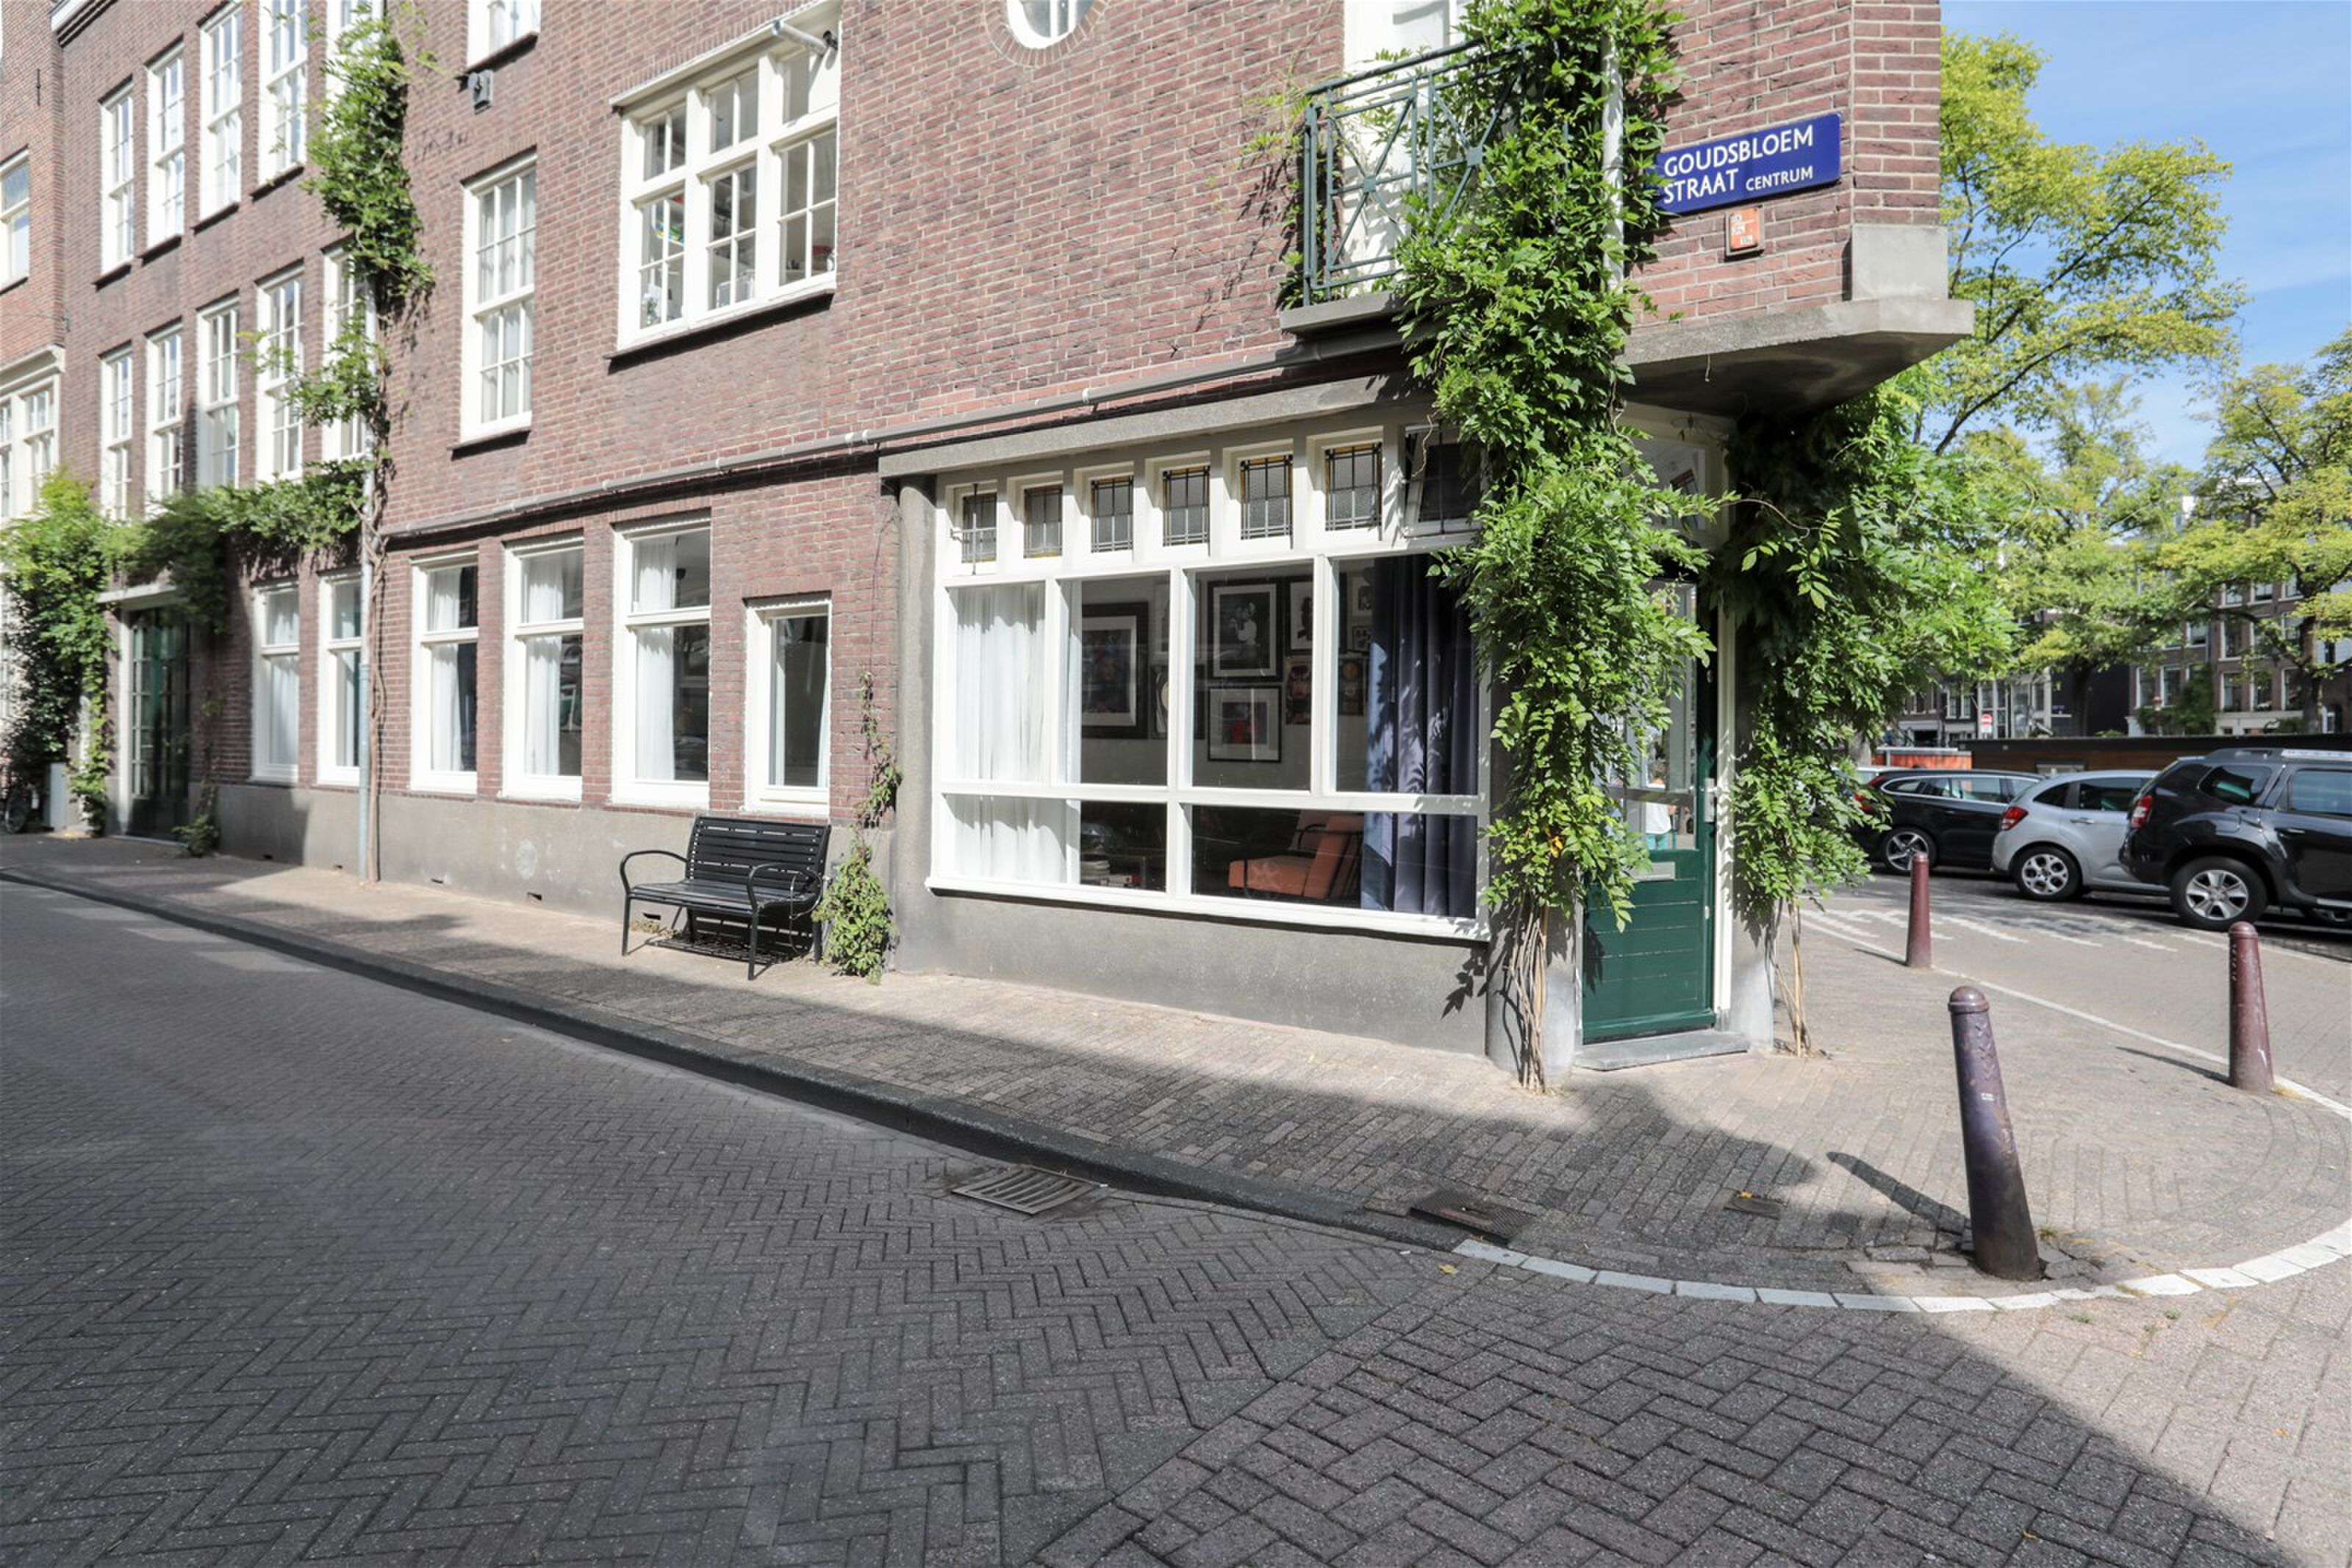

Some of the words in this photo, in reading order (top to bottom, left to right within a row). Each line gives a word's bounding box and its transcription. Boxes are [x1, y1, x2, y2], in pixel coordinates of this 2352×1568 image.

[1664, 124, 1813, 177] GOUDSBLOEM
[1663, 168, 1739, 204] STRAAT
[1746, 165, 1813, 191] CENTRUM
